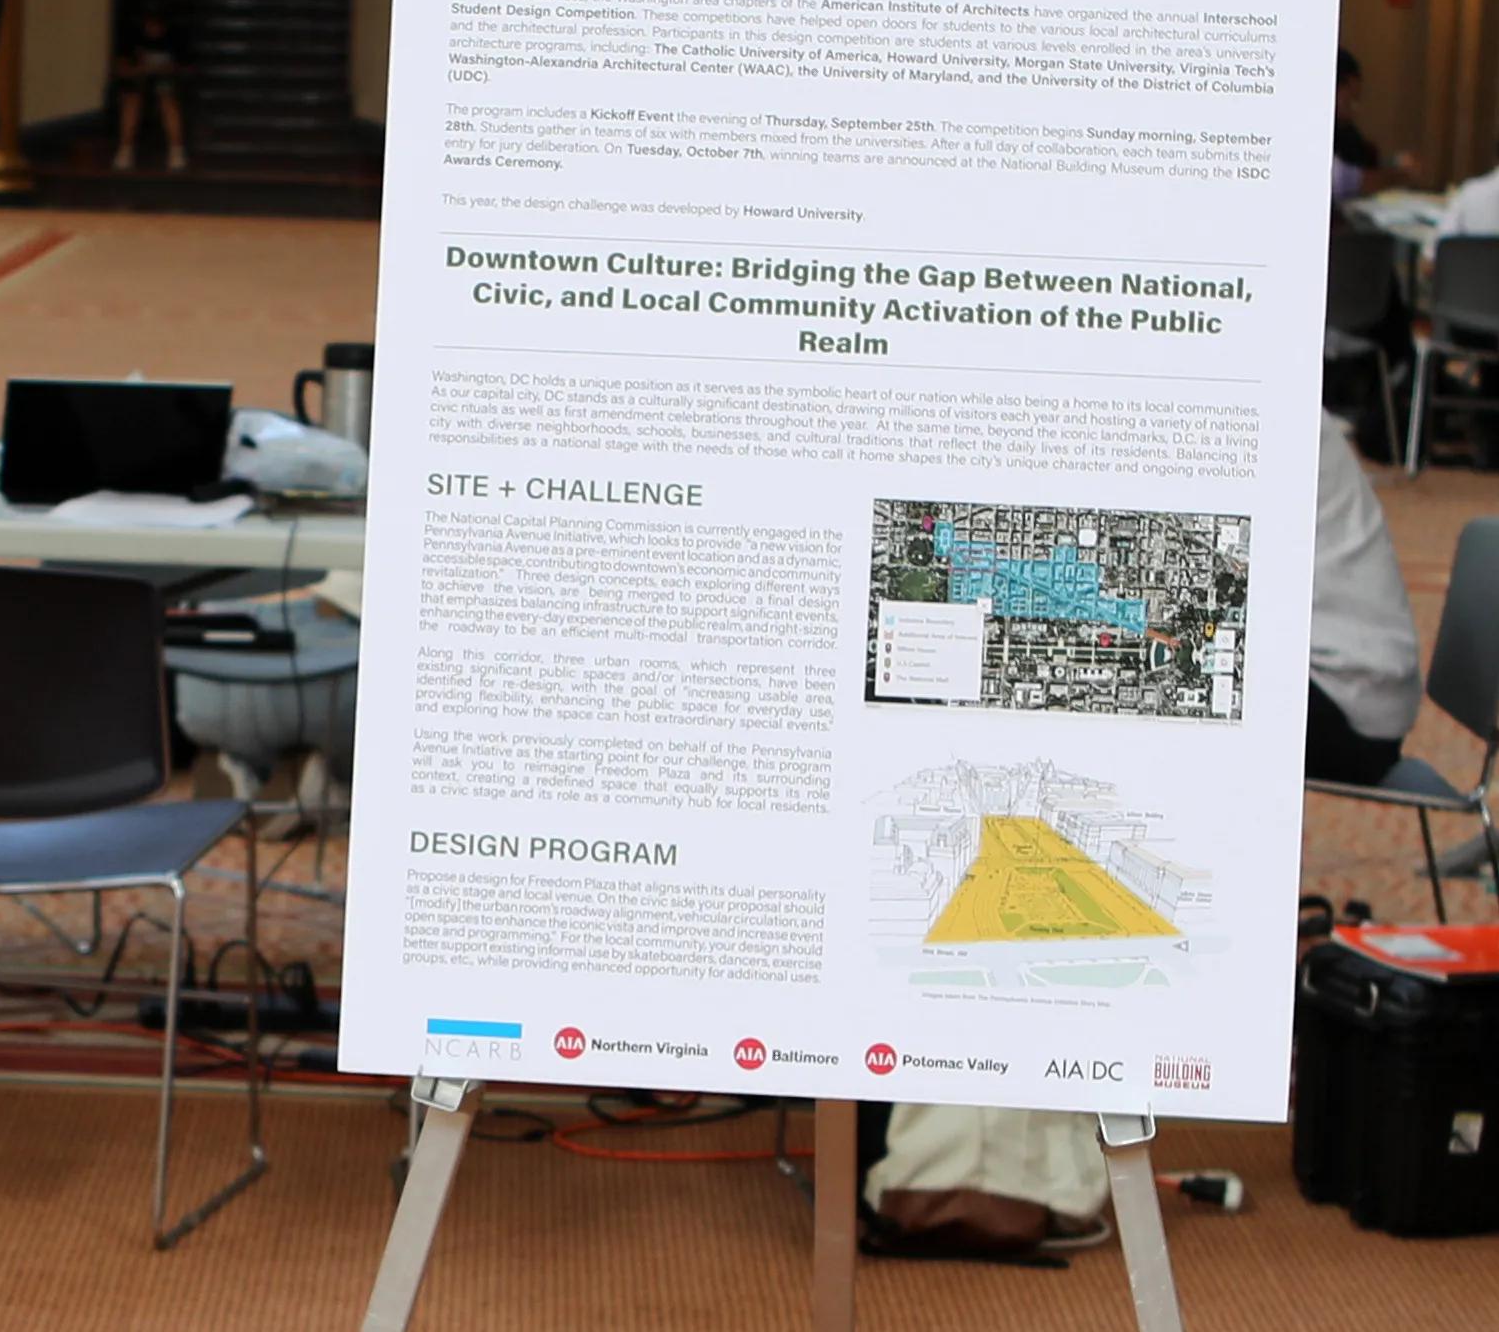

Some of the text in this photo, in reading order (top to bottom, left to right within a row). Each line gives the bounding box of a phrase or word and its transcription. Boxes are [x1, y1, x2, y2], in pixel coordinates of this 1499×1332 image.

[446, 245, 1252, 303] Downtown Culture: Bridging the Gap Between National,
[472, 281, 1222, 334] Civic, and Local Community Activation of the Public
[798, 330, 888, 355] Realm
[427, 472, 489, 497] SITE
[526, 477, 703, 507] CHALLENGE
[410, 830, 677, 866] DESIGN PROGRAM
